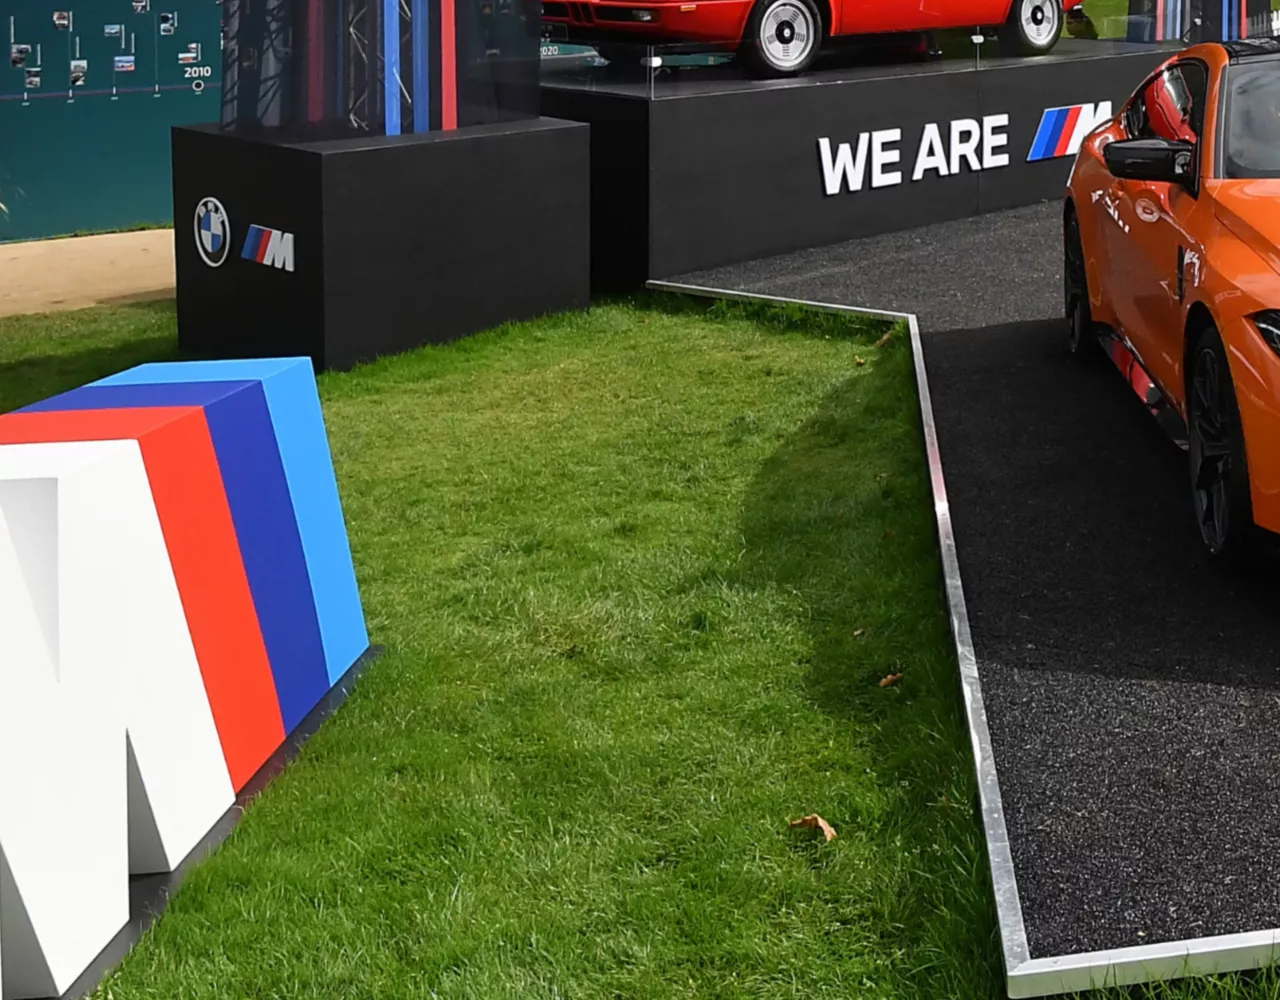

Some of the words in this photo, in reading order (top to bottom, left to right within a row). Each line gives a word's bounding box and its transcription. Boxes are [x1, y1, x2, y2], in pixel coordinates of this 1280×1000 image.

[184, 66, 211, 78] 2010
[817, 128, 902, 196] WE
[911, 113, 1010, 181] ARE
[261, 229, 295, 272] M
